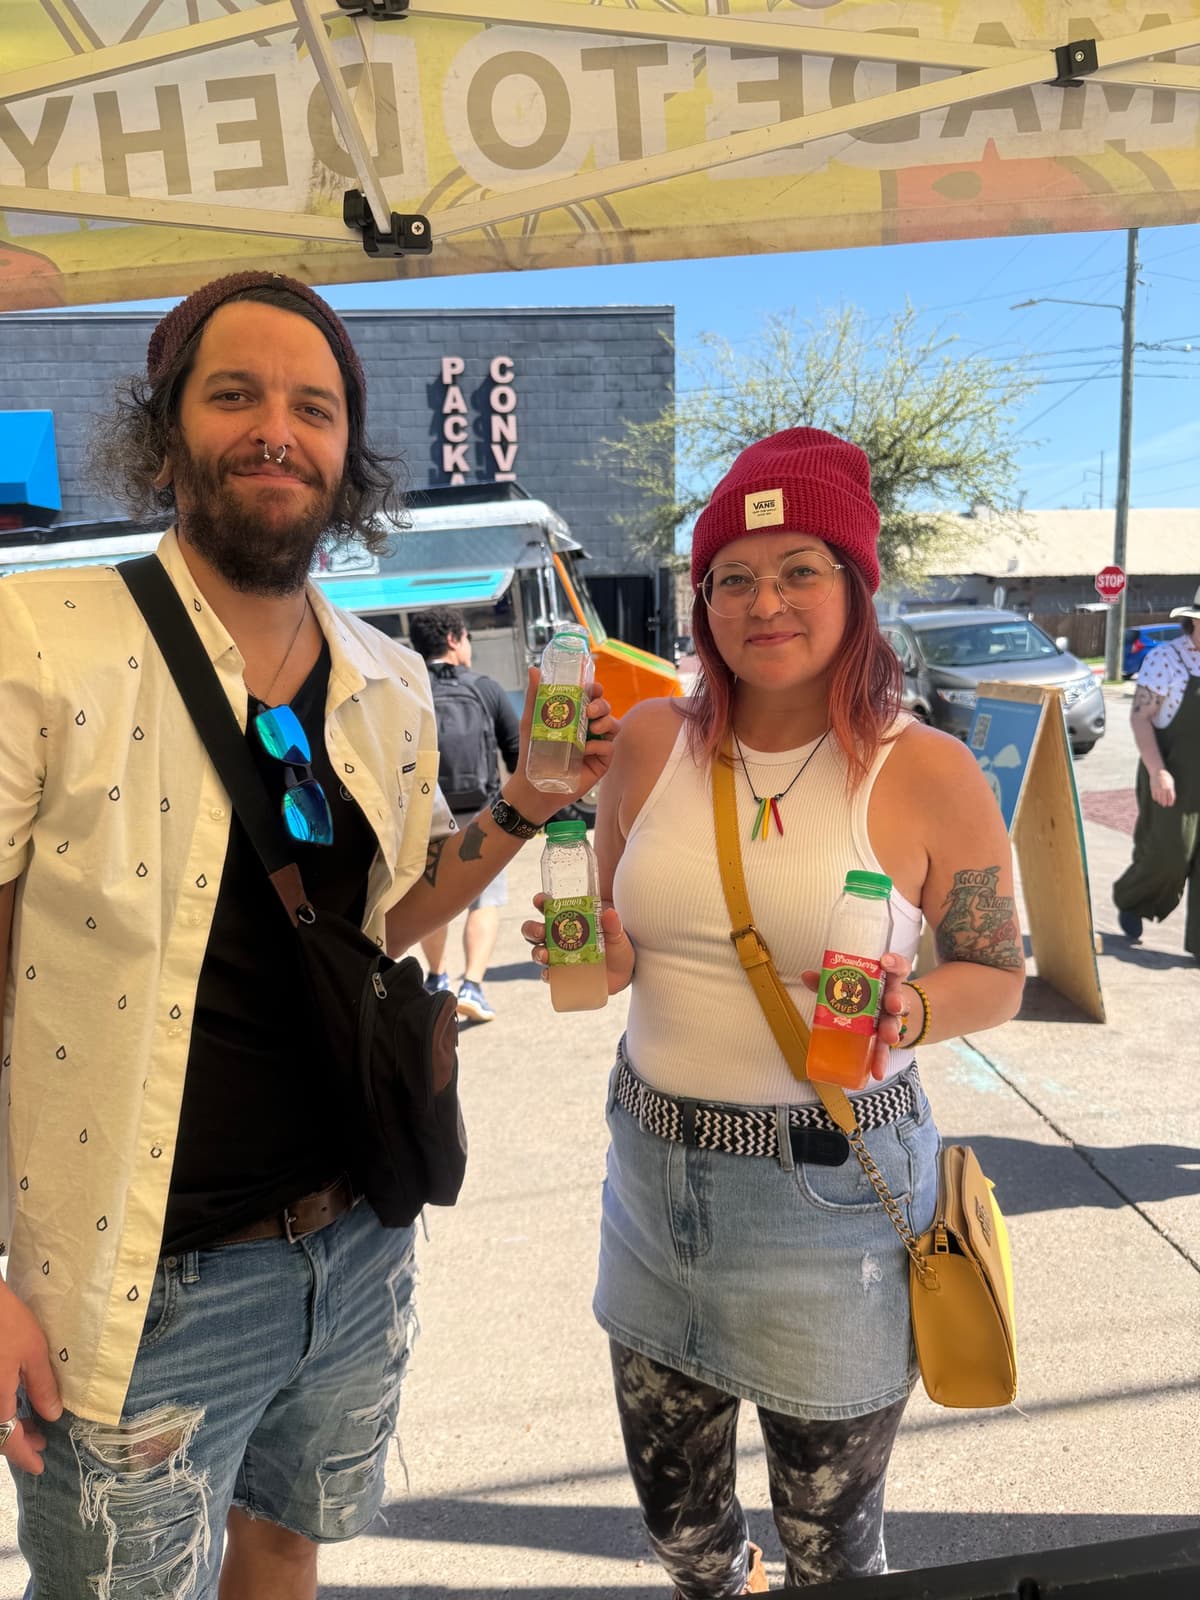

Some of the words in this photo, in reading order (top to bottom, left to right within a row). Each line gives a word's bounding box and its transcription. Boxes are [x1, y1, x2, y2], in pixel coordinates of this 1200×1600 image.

[752, 499, 776, 510] VANS
[1097, 573, 1124, 588] STOP
[959, 871, 990, 886] GOOD
[831, 954, 879, 973] Strawberry
[832, 970, 862, 982] FROOT
[830, 998, 858, 1013] KAVES
